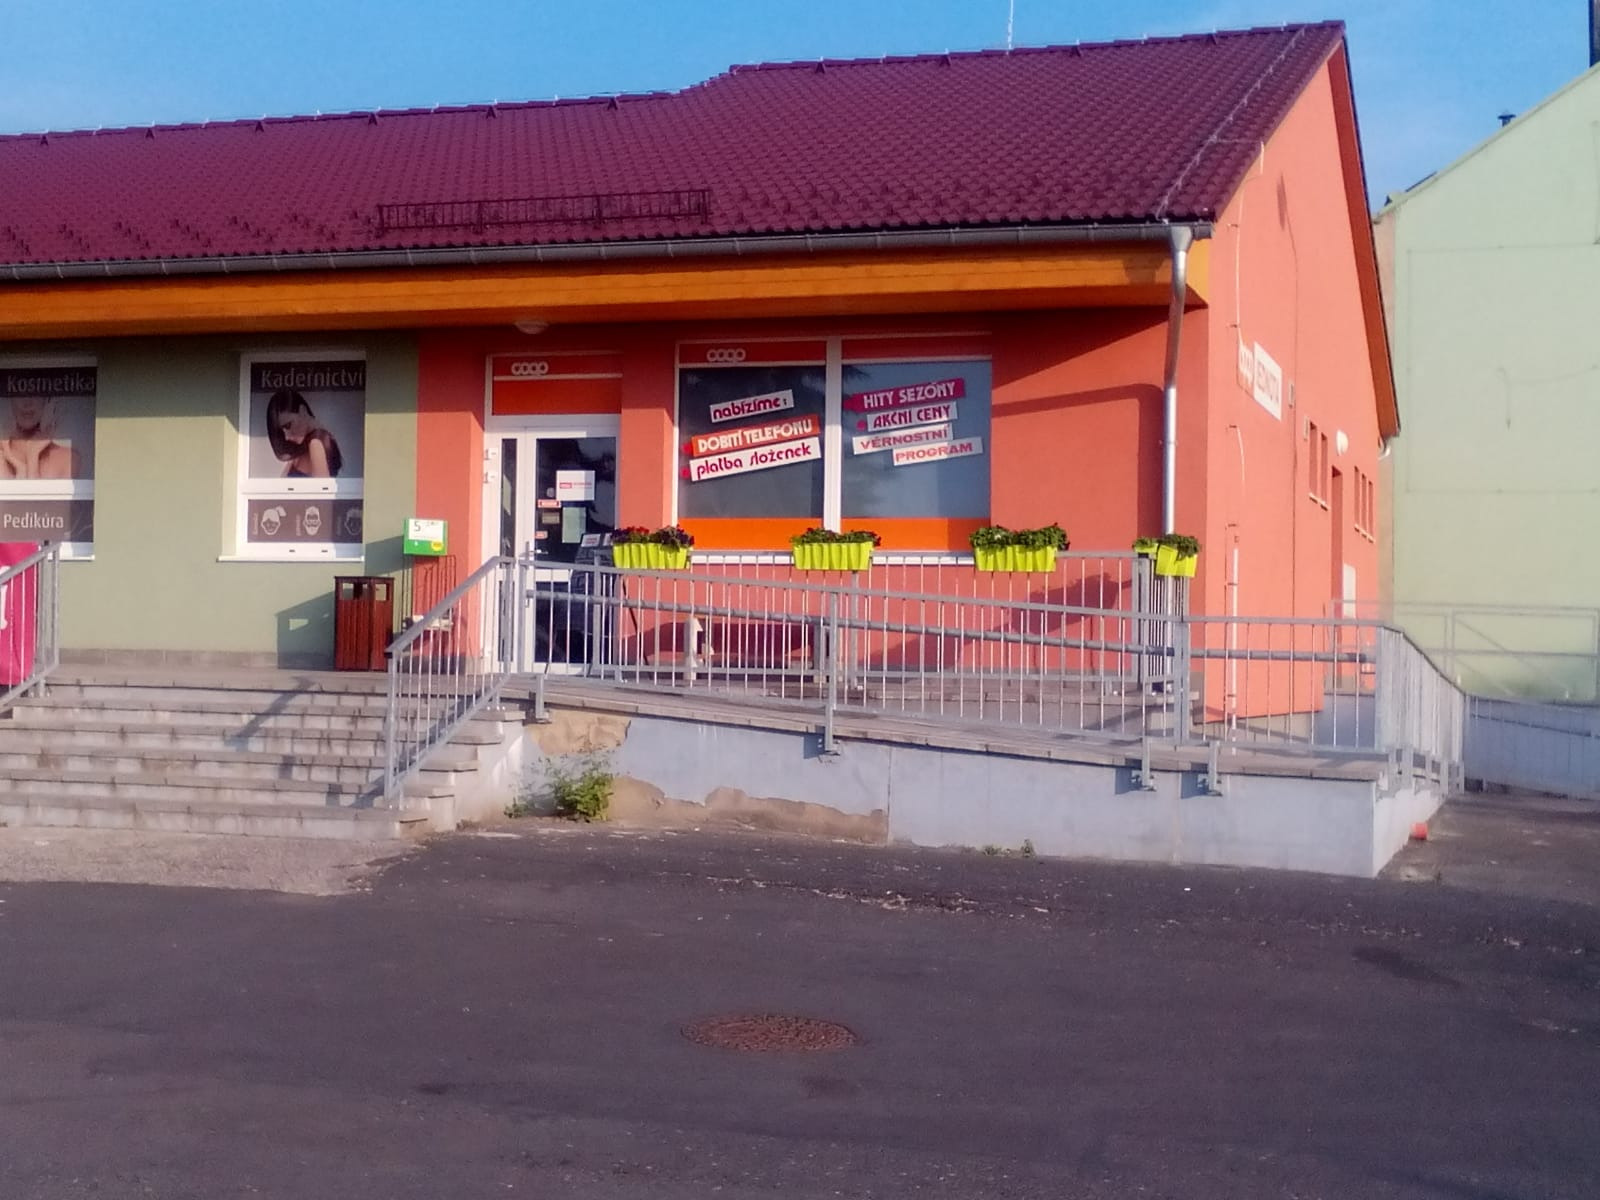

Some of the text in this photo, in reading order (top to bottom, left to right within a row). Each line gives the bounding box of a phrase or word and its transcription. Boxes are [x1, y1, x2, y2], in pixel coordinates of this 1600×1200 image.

[7, 372, 96, 393] Kosmetika
[261, 366, 363, 389] Kadeřnictví
[863, 381, 956, 409] HITY SEZÓNY
[917, 403, 951, 422] CENY
[698, 418, 812, 453] DOBITÍ TELEFONU
[697, 442, 811, 480] platba složenek
[895, 442, 973, 463] PROGRAM
[3, 511, 64, 529] Pedikúra
